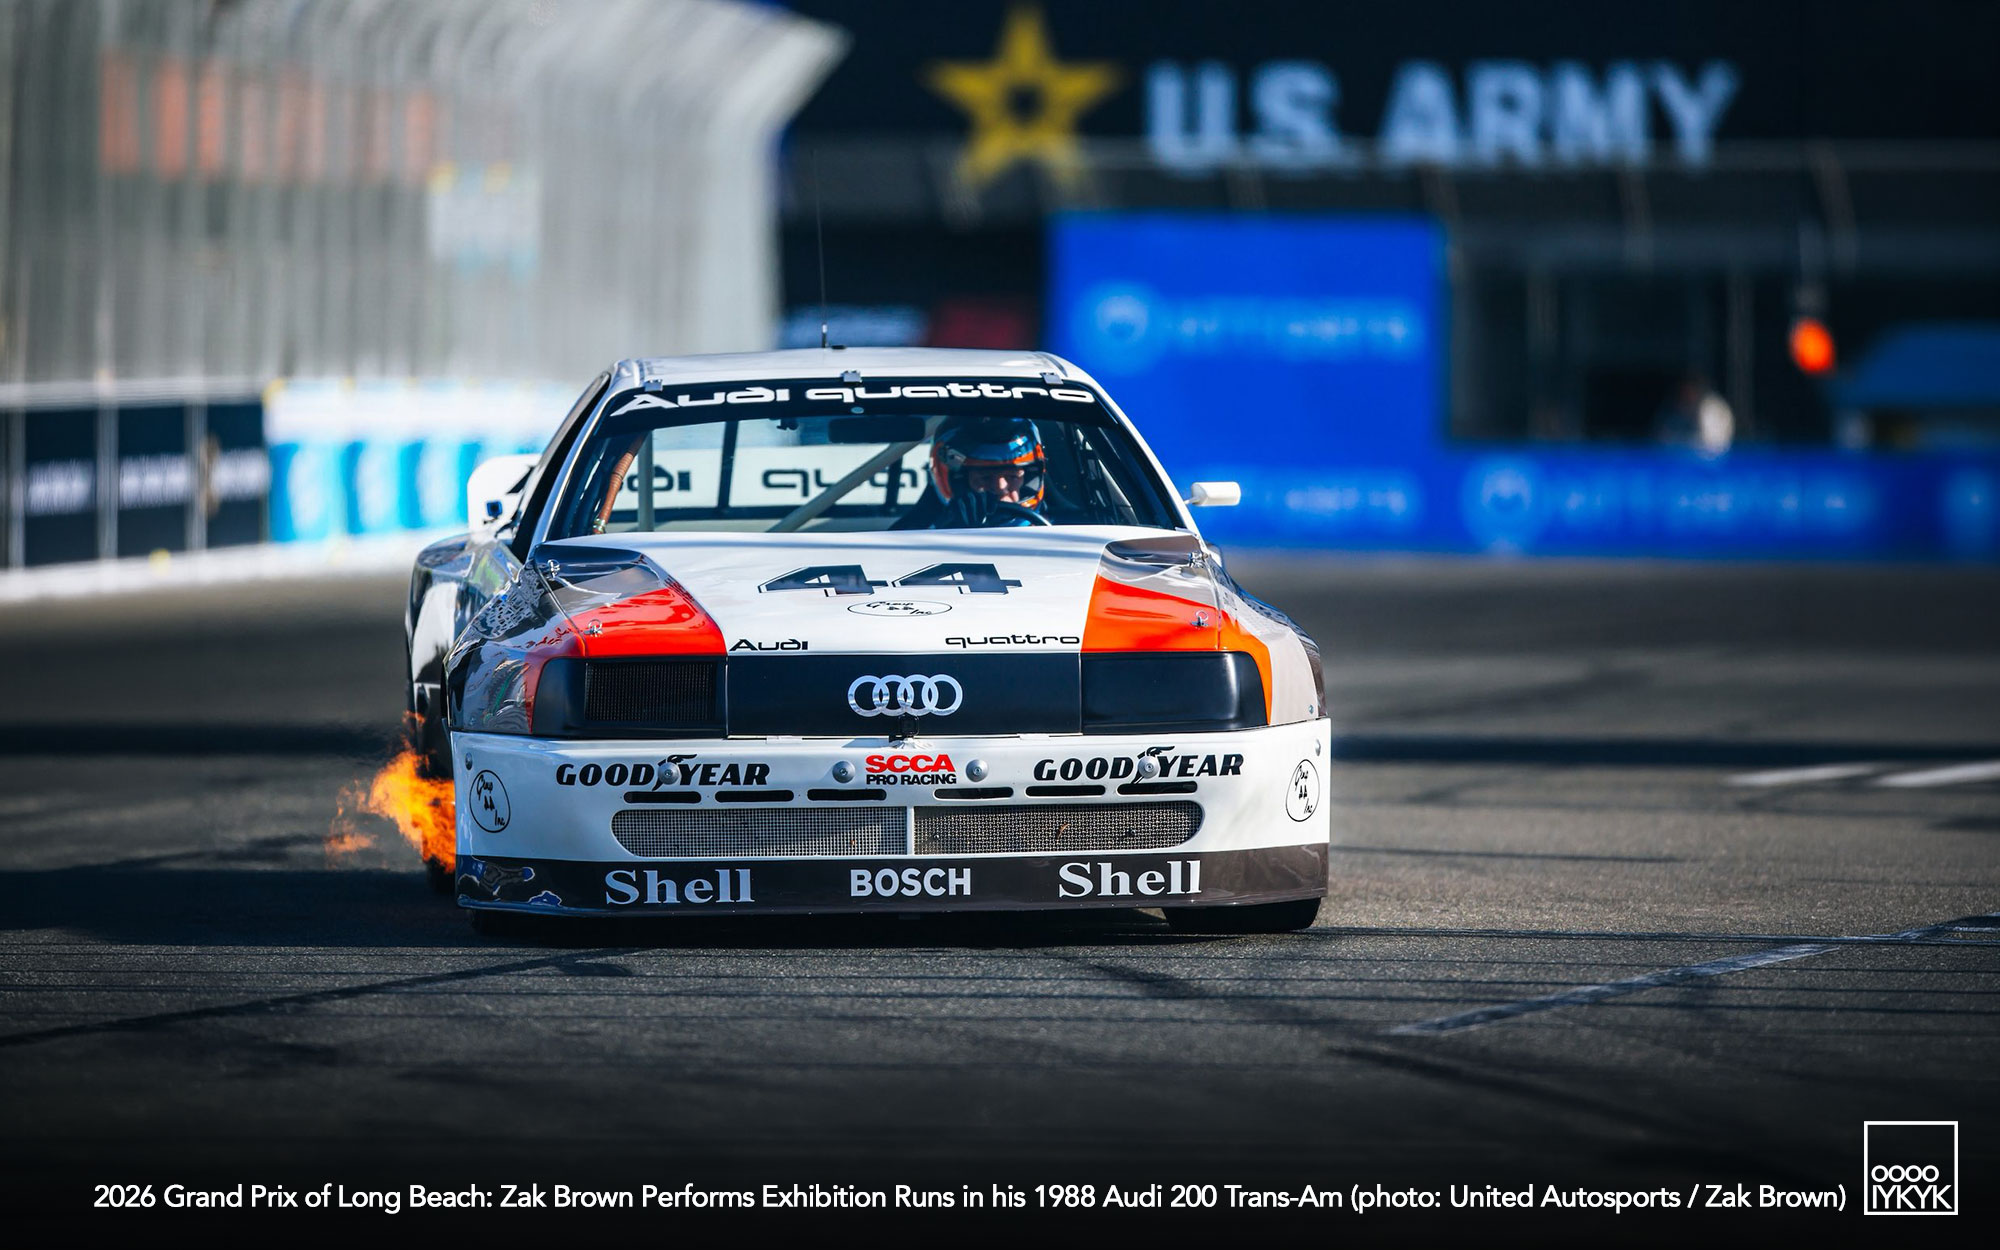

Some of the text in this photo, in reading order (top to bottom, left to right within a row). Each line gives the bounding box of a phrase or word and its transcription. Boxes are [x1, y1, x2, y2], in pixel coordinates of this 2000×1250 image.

[1380, 60, 1738, 170] ARMY
[610, 383, 1095, 417] Audi quattro
[757, 563, 1022, 598] 44
[729, 639, 809, 652] Audi
[945, 635, 1080, 649] quattro
[865, 754, 956, 774] SCCA
[866, 774, 957, 785] PRO RACING
[605, 868, 755, 905] Shell
[850, 868, 971, 897] BOSCH
[1058, 860, 1202, 898] Shell
